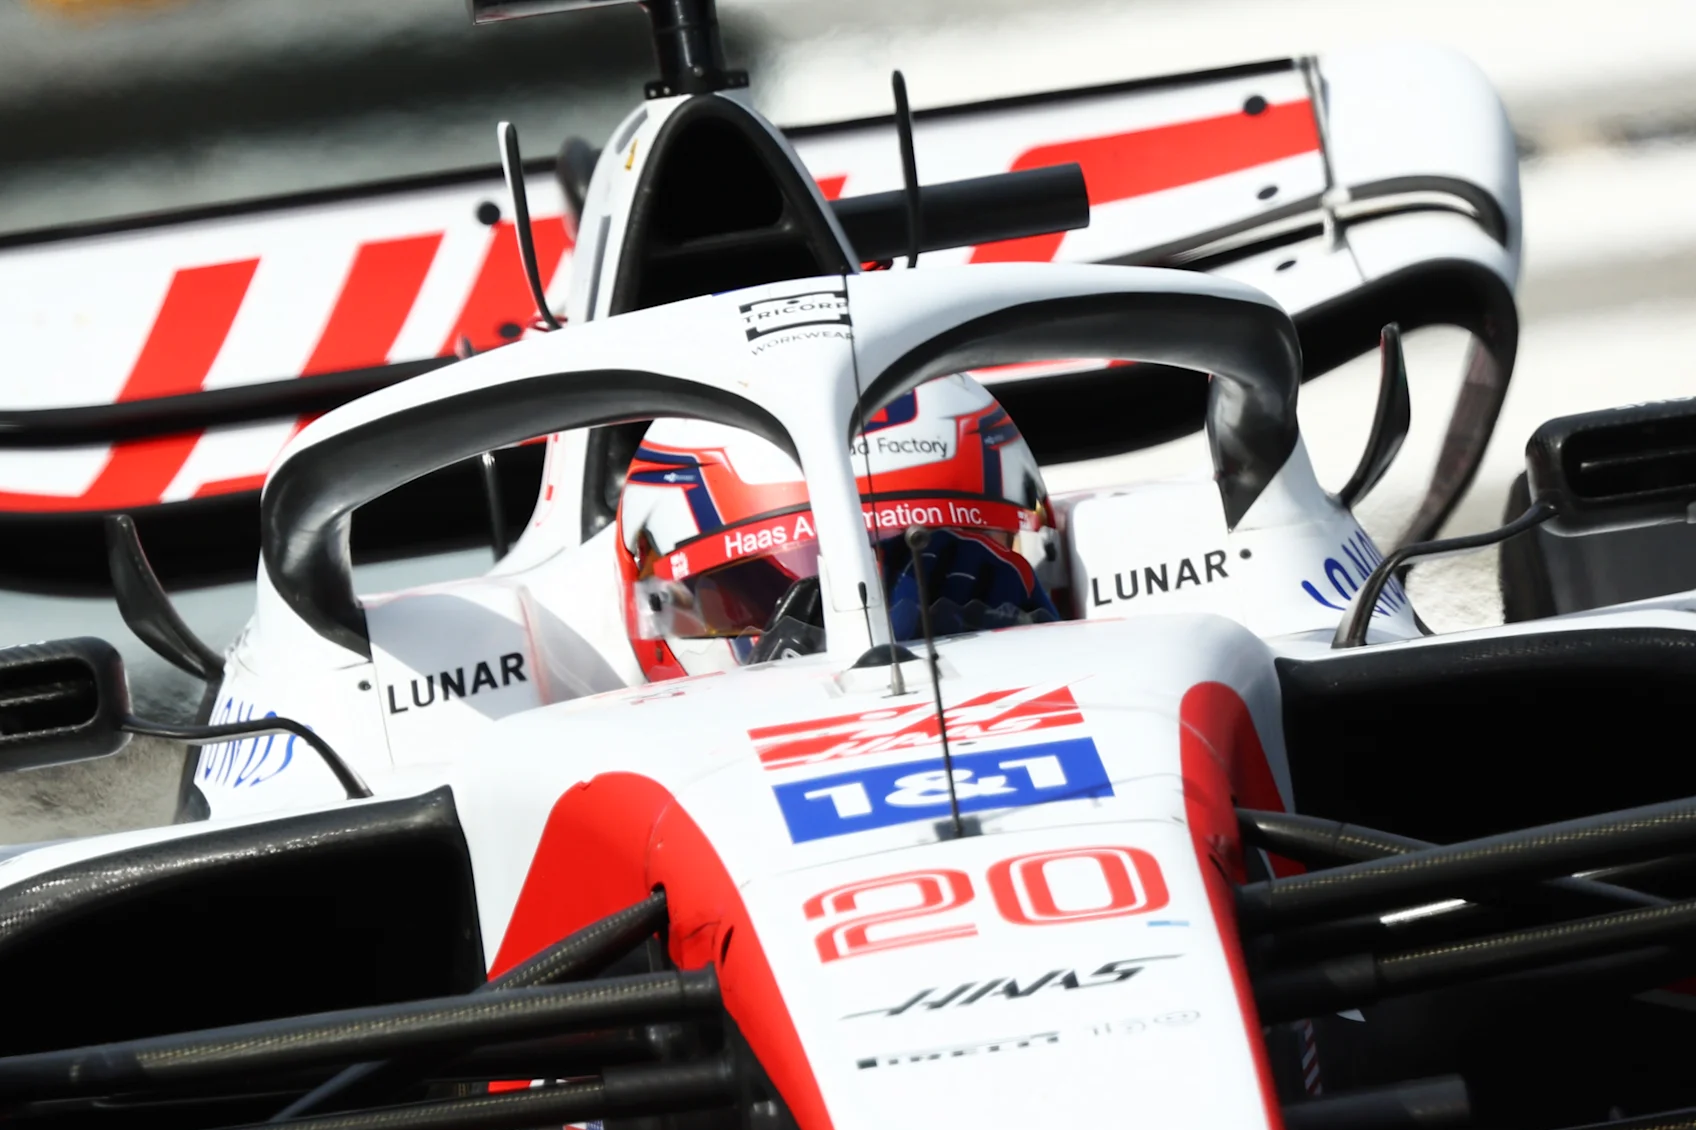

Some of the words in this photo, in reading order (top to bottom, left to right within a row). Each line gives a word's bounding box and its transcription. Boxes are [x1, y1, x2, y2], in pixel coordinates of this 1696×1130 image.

[876, 437, 949, 459] Factory
[724, 525, 787, 558] Haas
[948, 502, 988, 525] Inc.
[1091, 549, 1229, 607] LUNAR
[387, 652, 528, 715] LUNAR
[804, 755, 1067, 819] 1&1
[803, 846, 1169, 963] 20
